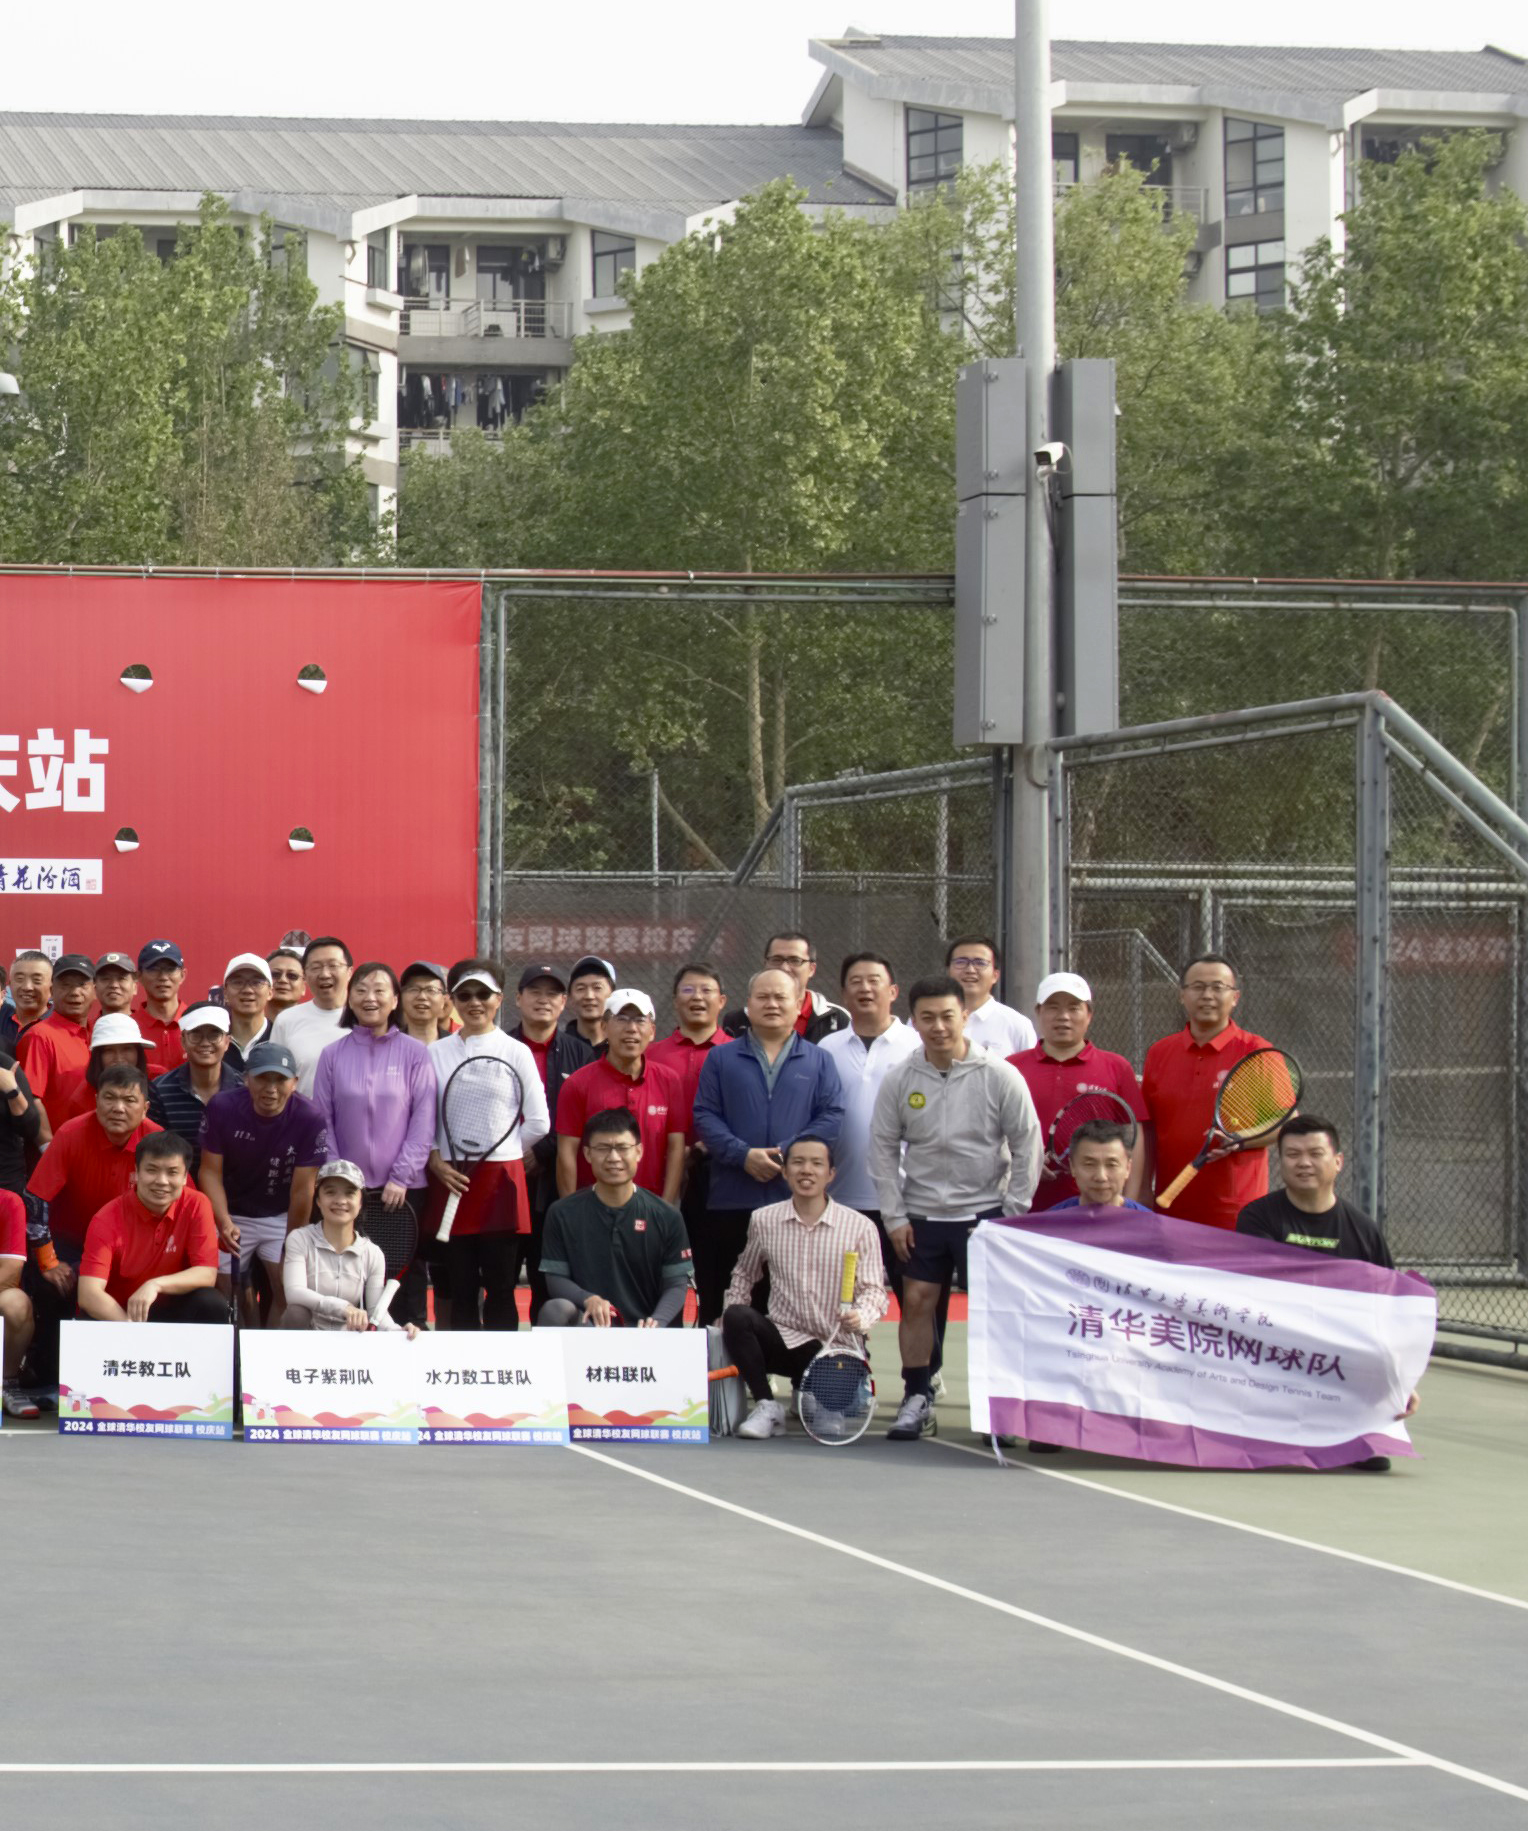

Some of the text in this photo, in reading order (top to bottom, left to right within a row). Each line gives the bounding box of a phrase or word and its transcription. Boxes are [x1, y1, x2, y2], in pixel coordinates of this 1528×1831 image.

[1067, 1302, 1346, 1382] 清华美院网球队
[102, 1359, 192, 1378] 清华教工队
[285, 1367, 374, 1386] 电子紫荆队
[426, 1368, 532, 1386] 水力数工联队
[585, 1366, 657, 1383] 材料联队
[1066, 1350, 1109, 1363] Tsinghua
[1154, 1363, 1195, 1379] Academy
[1197, 1371, 1207, 1379] of
[1209, 1372, 1228, 1383] Arts
[1230, 1376, 1247, 1386] and
[1249, 1379, 1279, 1393] Design
[1282, 1384, 1313, 1398] Tennis
[1315, 1390, 1342, 1402] Team
[64, 1421, 94, 1432] 2024
[249, 1429, 280, 1440] 2024
